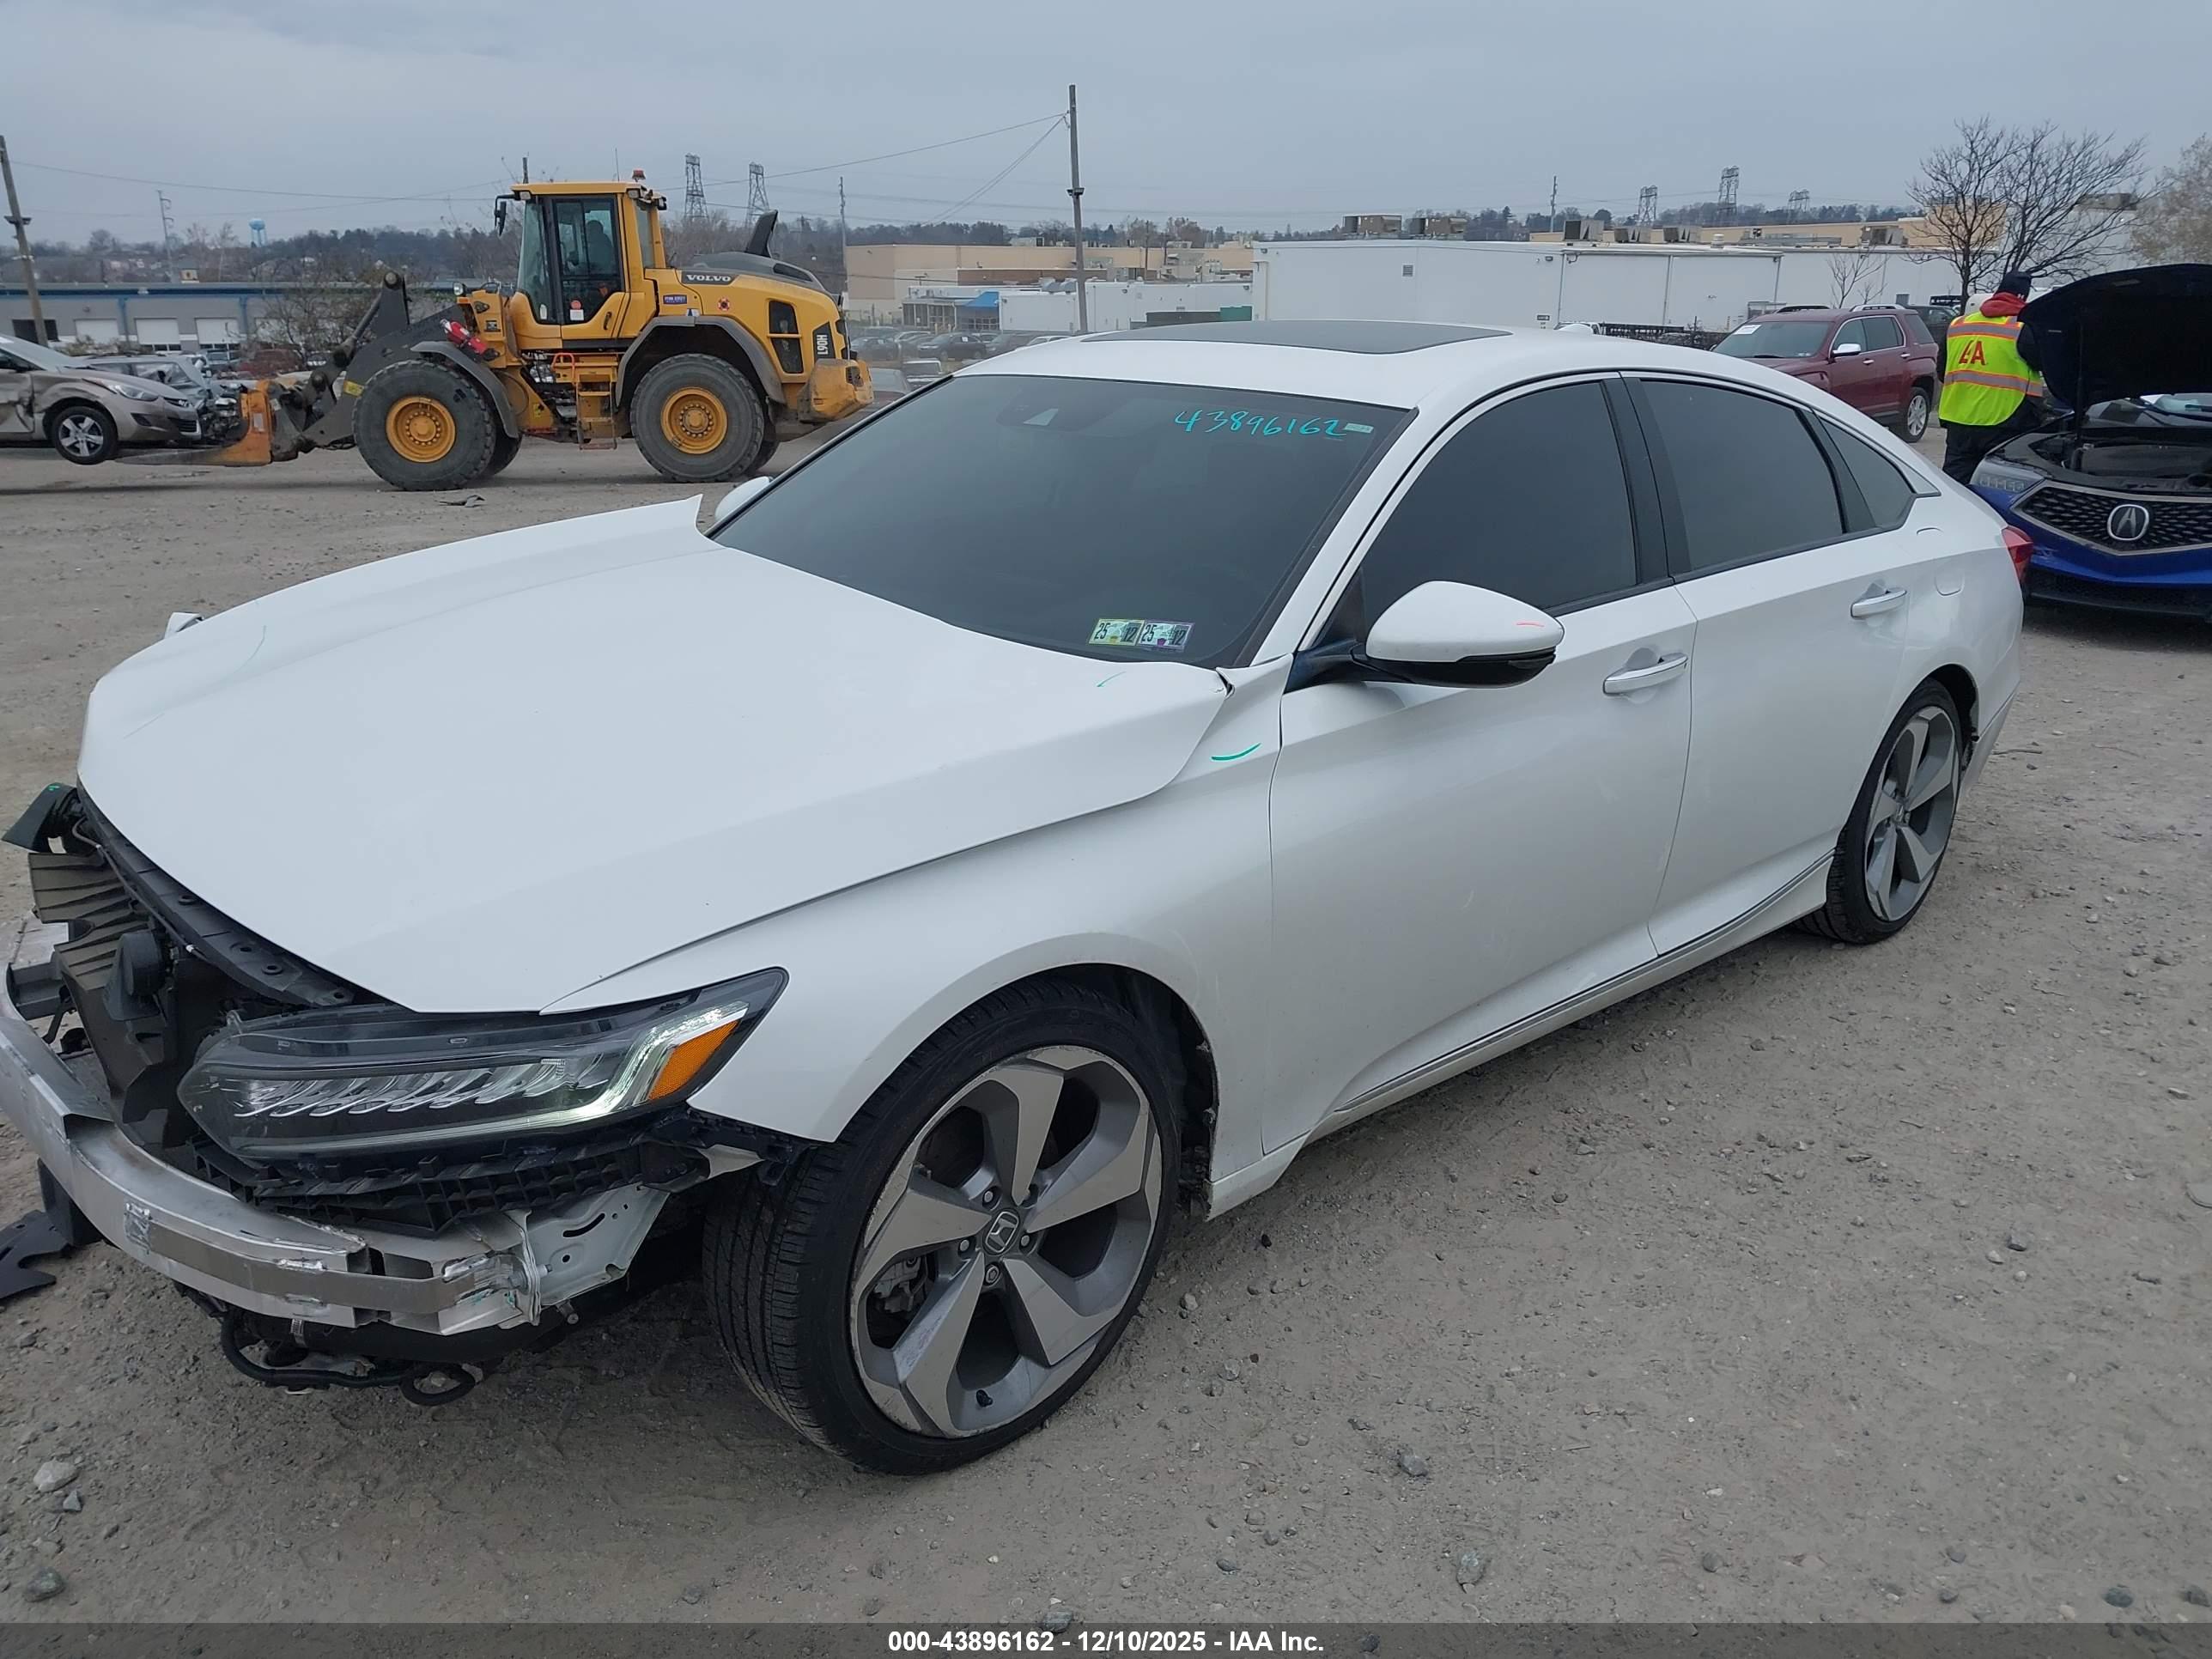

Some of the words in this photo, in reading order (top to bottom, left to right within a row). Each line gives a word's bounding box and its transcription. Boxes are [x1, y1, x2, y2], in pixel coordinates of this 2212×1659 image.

[686, 274, 732, 283] VOLVO
[816, 334, 829, 356] L90H
[1174, 409, 1347, 437] 43896162
[1094, 623, 1110, 640] 25
[1122, 626, 1139, 642] 12
[1141, 624, 1158, 642] 25
[1171, 629, 1188, 646] 12
